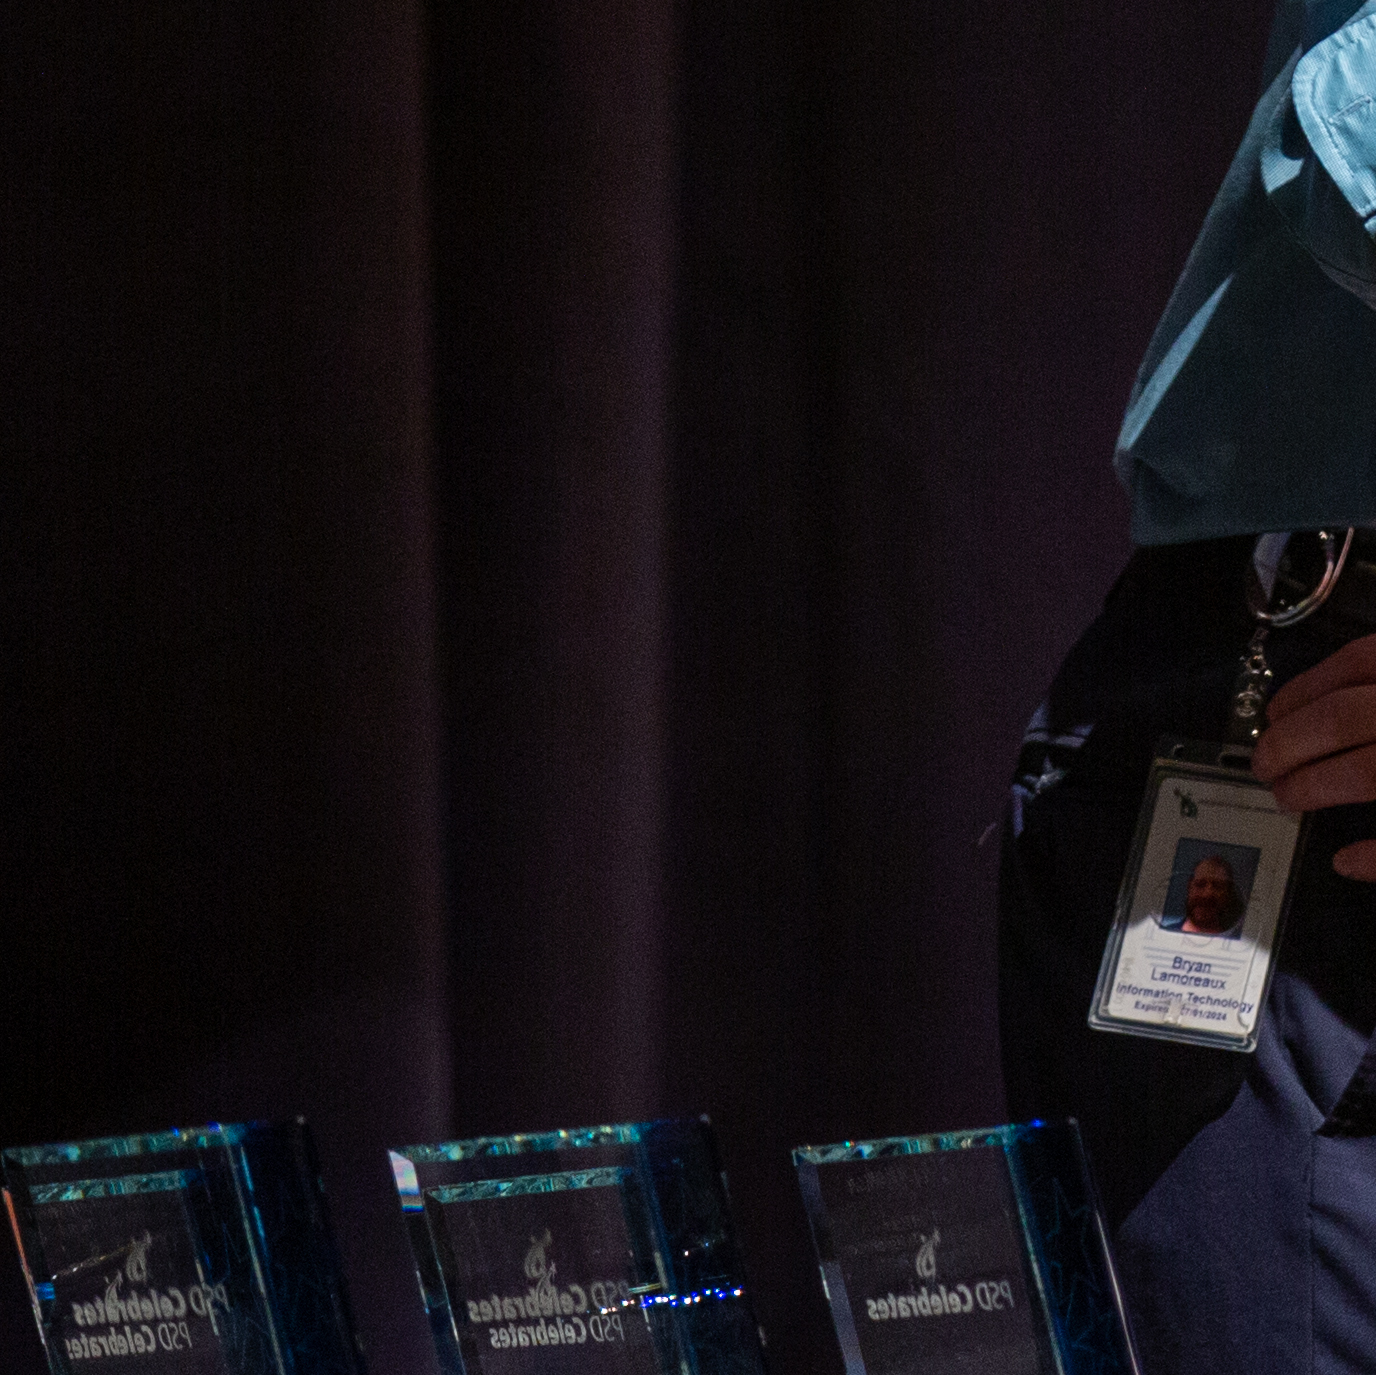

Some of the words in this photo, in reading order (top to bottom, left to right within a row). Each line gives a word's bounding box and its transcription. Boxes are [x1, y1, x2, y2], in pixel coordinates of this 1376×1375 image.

[1171, 955, 1212, 974] Bryan
[1150, 968, 1227, 991] Lamoreaux
[1116, 983, 1183, 1001] Information
[1187, 993, 1255, 1014] Technology
